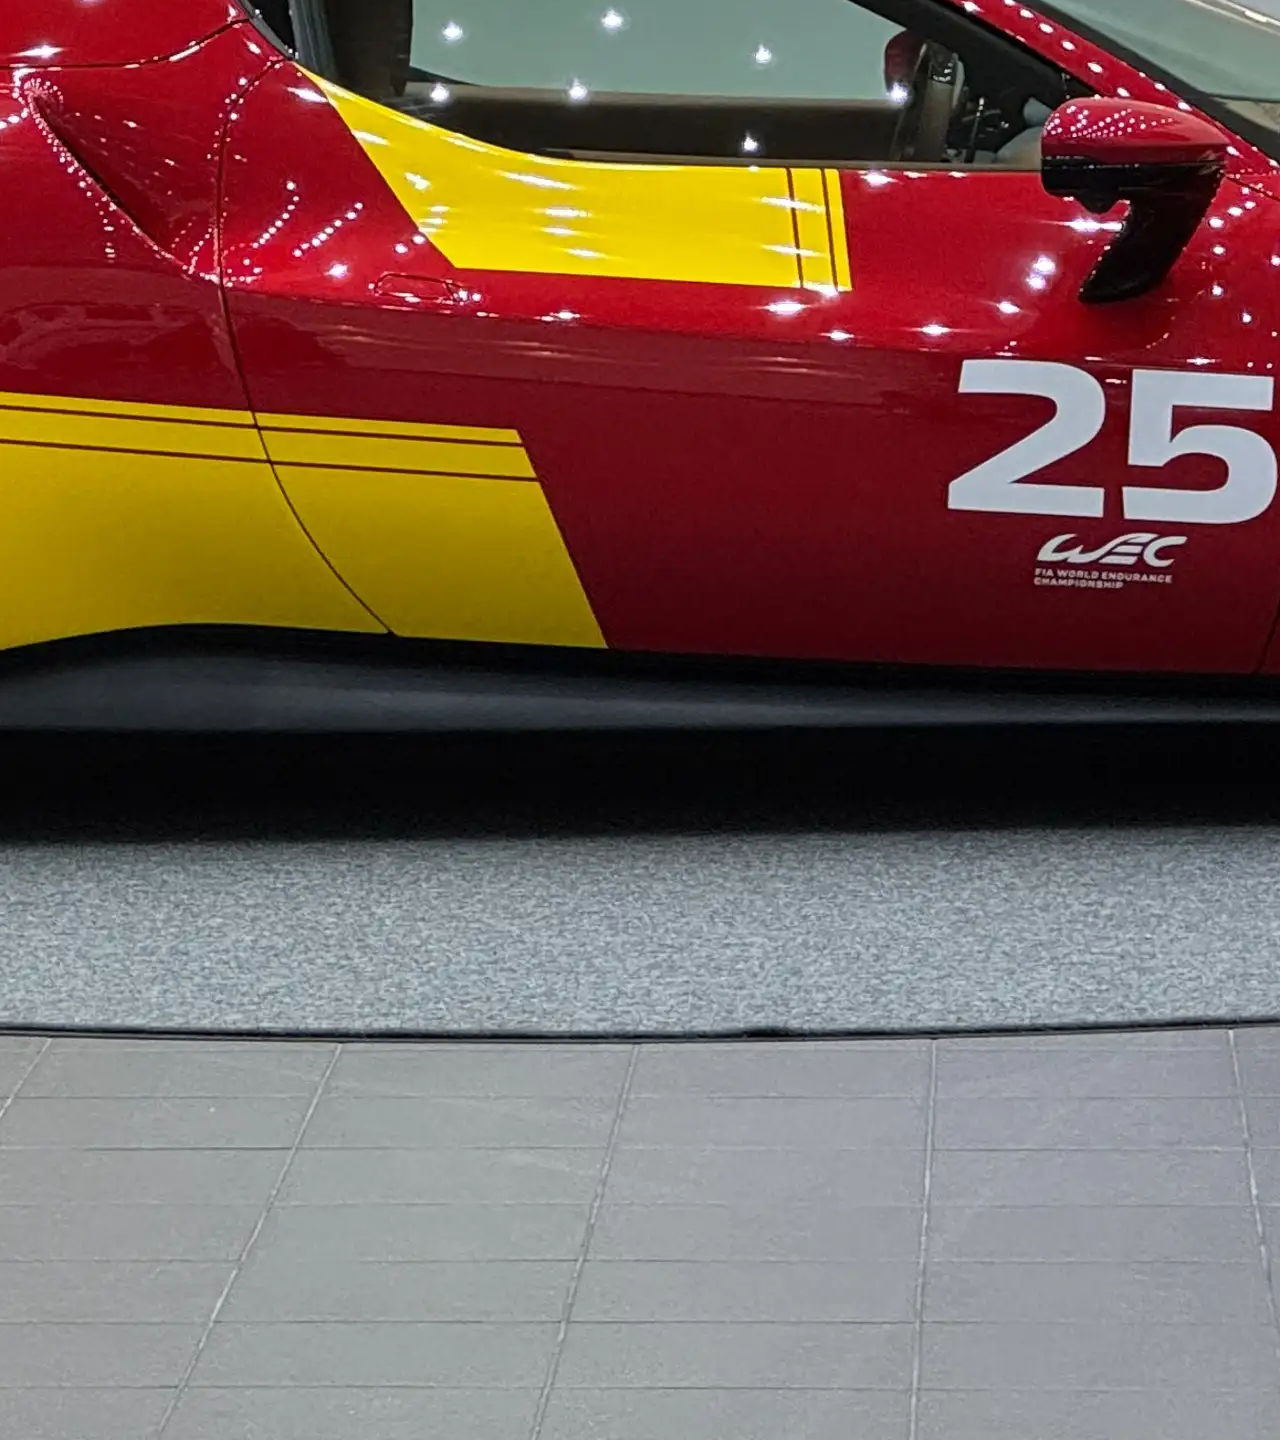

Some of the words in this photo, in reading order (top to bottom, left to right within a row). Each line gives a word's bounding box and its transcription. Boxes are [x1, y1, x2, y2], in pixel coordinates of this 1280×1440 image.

[947, 359, 1278, 524] 25
[1036, 532, 1188, 567] WEC
[1033, 577, 1124, 589] CHAMPIONSHIP
[1034, 567, 1054, 577] FIA
[1056, 569, 1099, 580] WORLD
[1101, 571, 1173, 584] ENDURANCE
